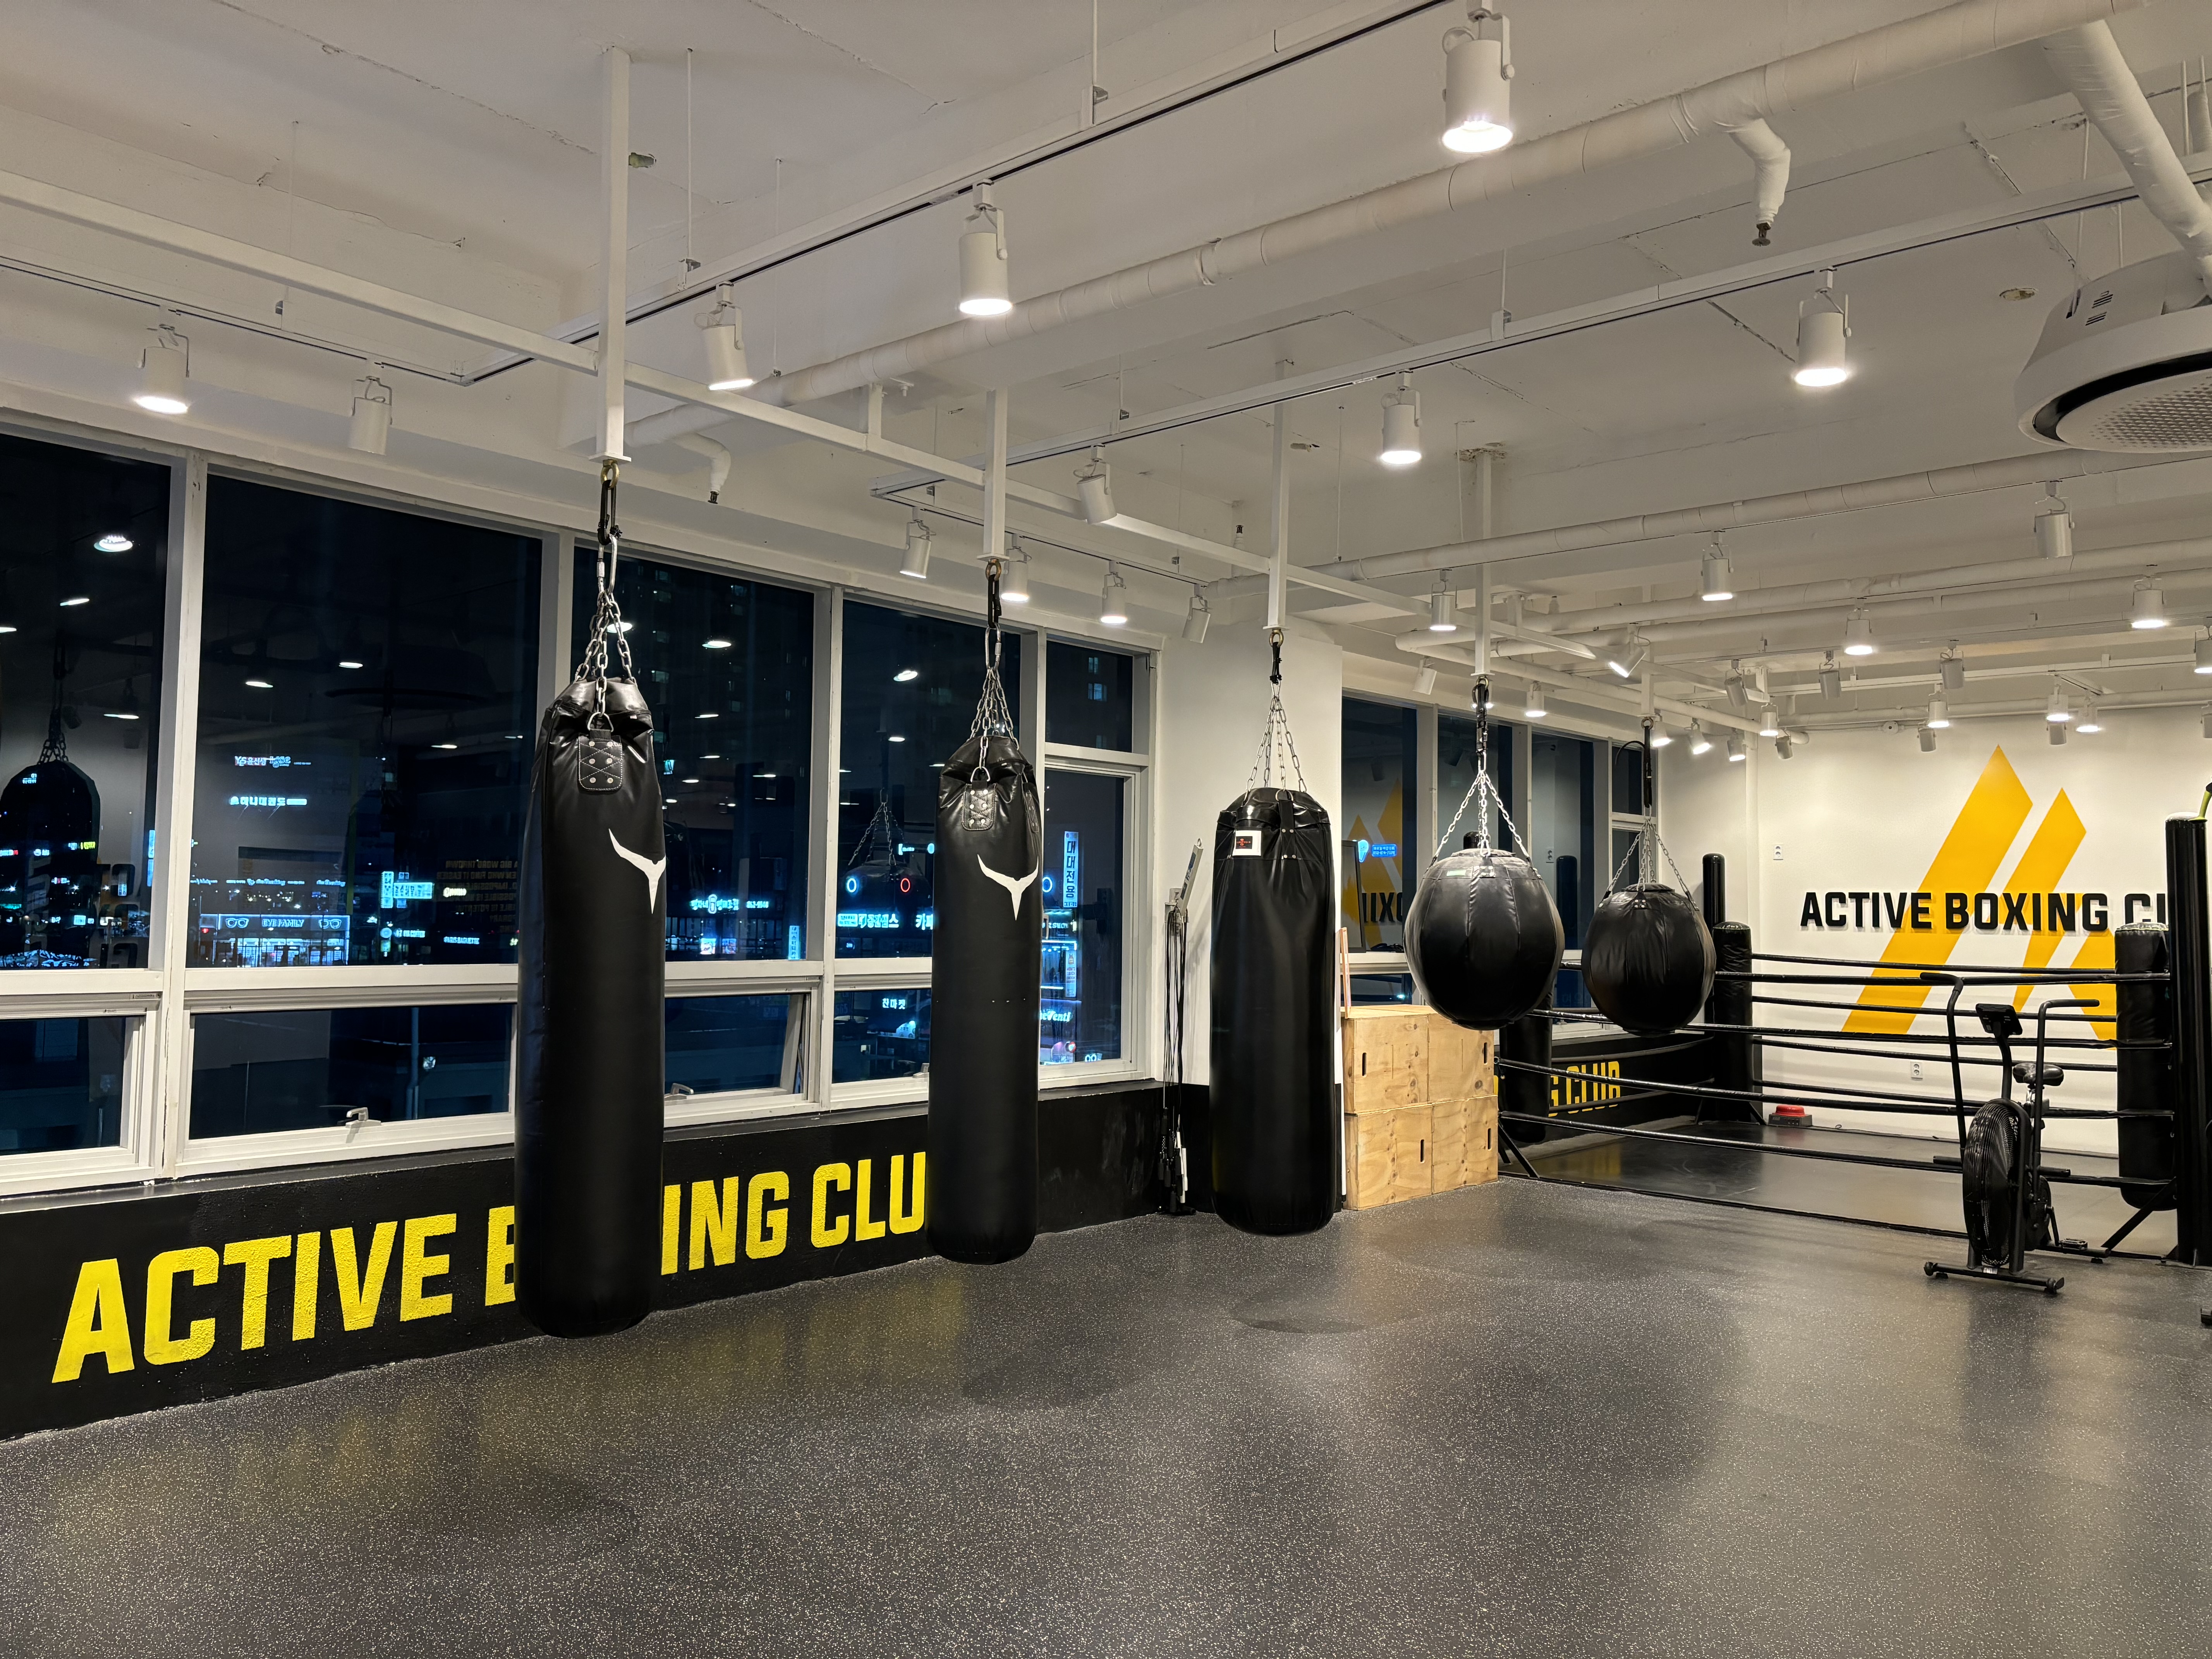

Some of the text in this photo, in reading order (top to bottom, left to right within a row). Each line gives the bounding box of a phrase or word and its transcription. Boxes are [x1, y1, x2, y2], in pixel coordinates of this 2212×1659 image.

[1066, 840, 1077, 898] 대대전용
[277, 919, 305, 927] FAMILY
[1800, 892, 1932, 929] ACTIVE
[1945, 892, 2108, 931] BOXING
[1566, 1061, 1621, 1114] CLUB
[51, 1151, 926, 1383] ACTIVE BING CLU
